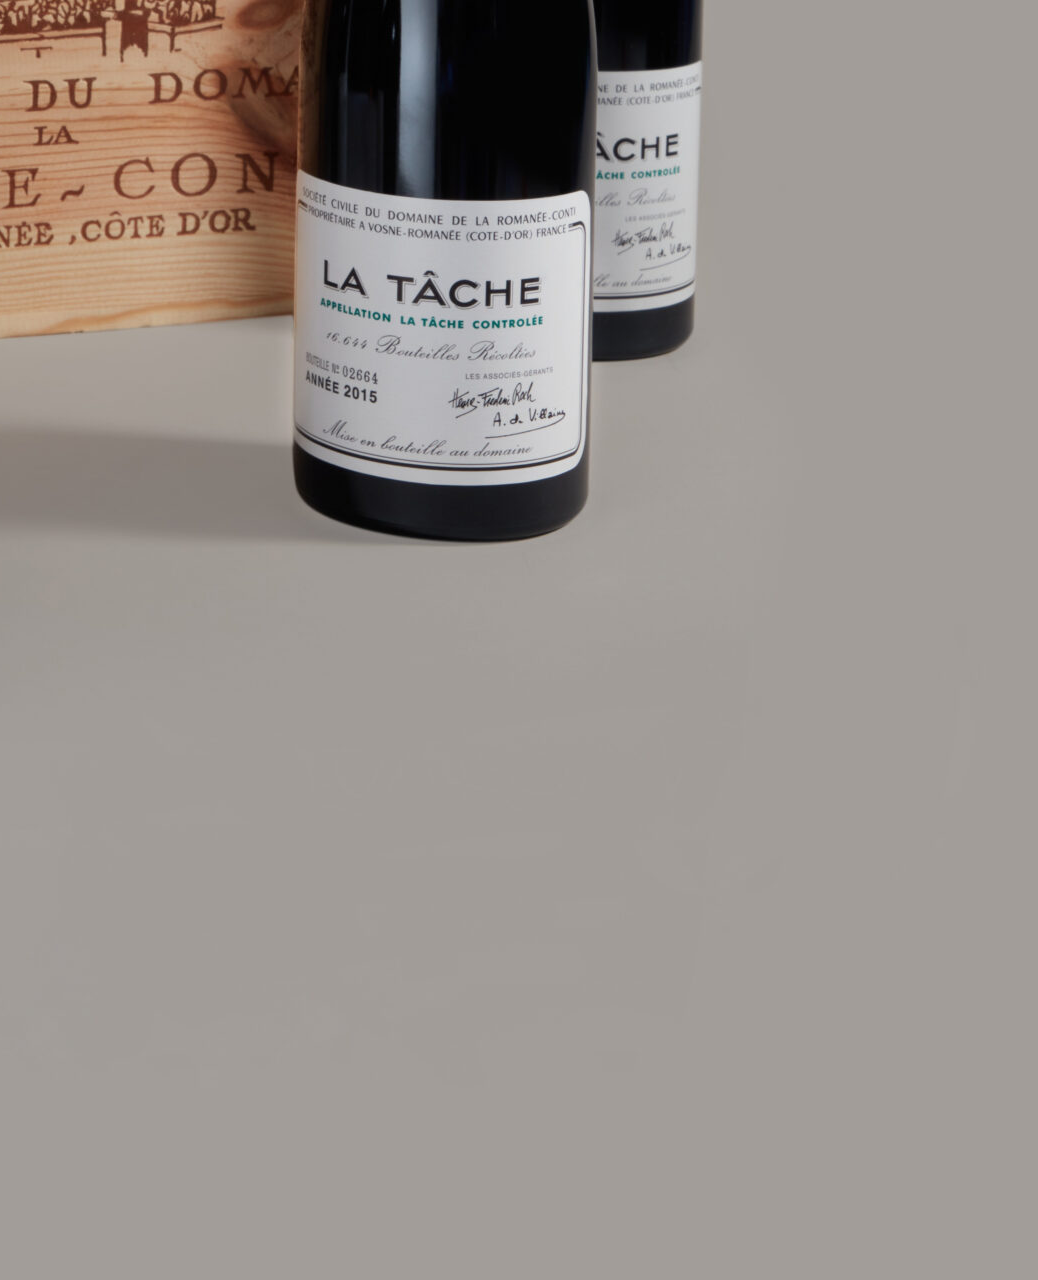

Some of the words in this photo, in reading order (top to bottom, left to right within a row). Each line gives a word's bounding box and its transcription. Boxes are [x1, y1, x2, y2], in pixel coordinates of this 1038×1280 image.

[24, 76, 97, 112] DU
[615, 84, 627, 93] DE
[634, 83, 645, 93] LA
[33, 125, 79, 146] LA
[176, 207, 256, 236] D'OR
[308, 205, 356, 229] PROPRIÉTAIRE
[359, 220, 366, 231] A
[368, 222, 461, 240] VOSNE-ROMANÉE
[536, 224, 567, 238] FRANCE
[330, 198, 359, 214] CIVILE
[365, 206, 381, 218] DU
[388, 210, 443, 225] DOMAINE
[452, 215, 467, 226] DE
[475, 216, 490, 226] LA
[497, 207, 576, 226] ROMANÉE-CONTI
[323, 259, 369, 299] LA
[386, 270, 541, 309] TÂCHE
[320, 298, 392, 323] APPELLATION
[400, 315, 416, 326] LA
[421, 316, 464, 329] TÂCHE
[472, 315, 544, 330] CONTROLÉE
[375, 334, 460, 361] Bouteilles
[467, 340, 536, 362] Récoltées
[305, 370, 340, 394] ANNÉE
[344, 384, 378, 404] 2015
[342, 365, 378, 385] 02664
[465, 372, 480, 380] LES
[323, 419, 358, 442] Mise
[360, 439, 376, 448] en
[380, 435, 446, 457] bouteille
[449, 449, 468, 457] au
[473, 442, 532, 457] domaine
